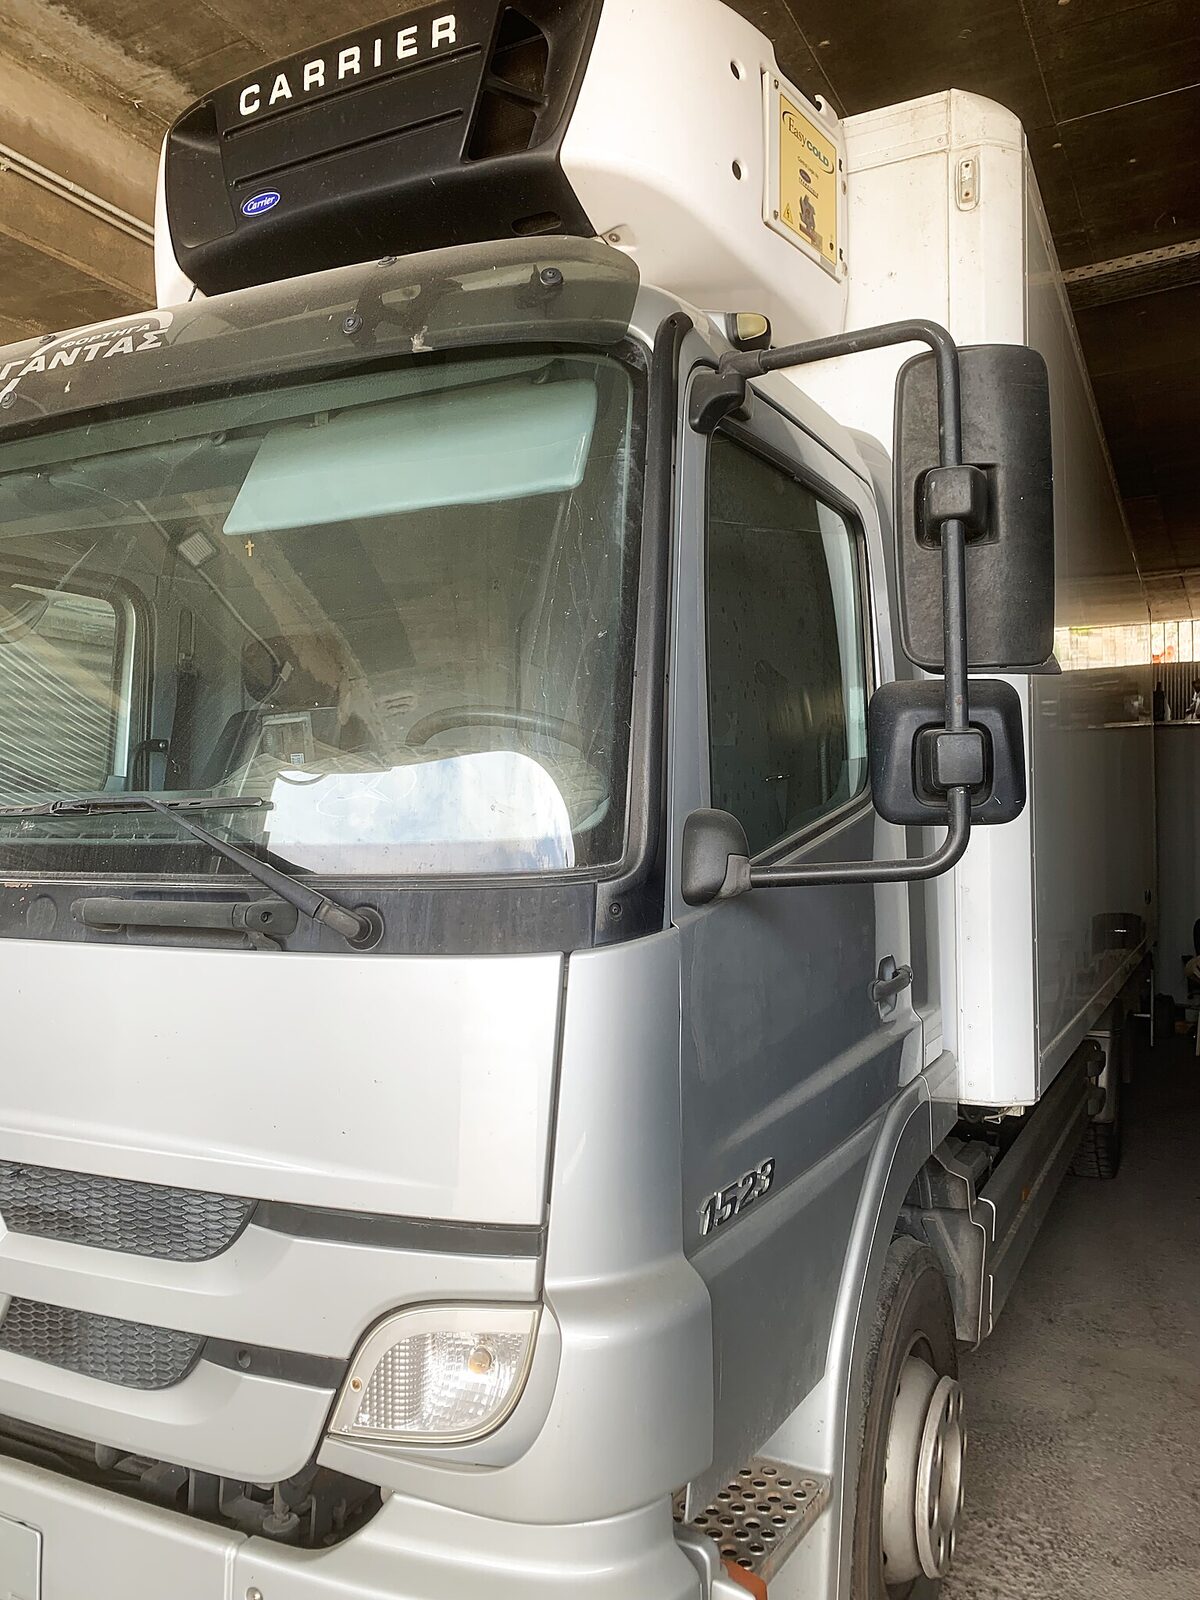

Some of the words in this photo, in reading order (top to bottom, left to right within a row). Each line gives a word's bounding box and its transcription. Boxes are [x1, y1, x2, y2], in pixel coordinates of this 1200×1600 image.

[239, 14, 457, 116] CARRIER
[247, 196, 276, 212] Carrier
[0, 329, 169, 381] ΓΑΝΤΑΣ
[60, 323, 150, 349] ΦΟΡΤΗΓΑ
